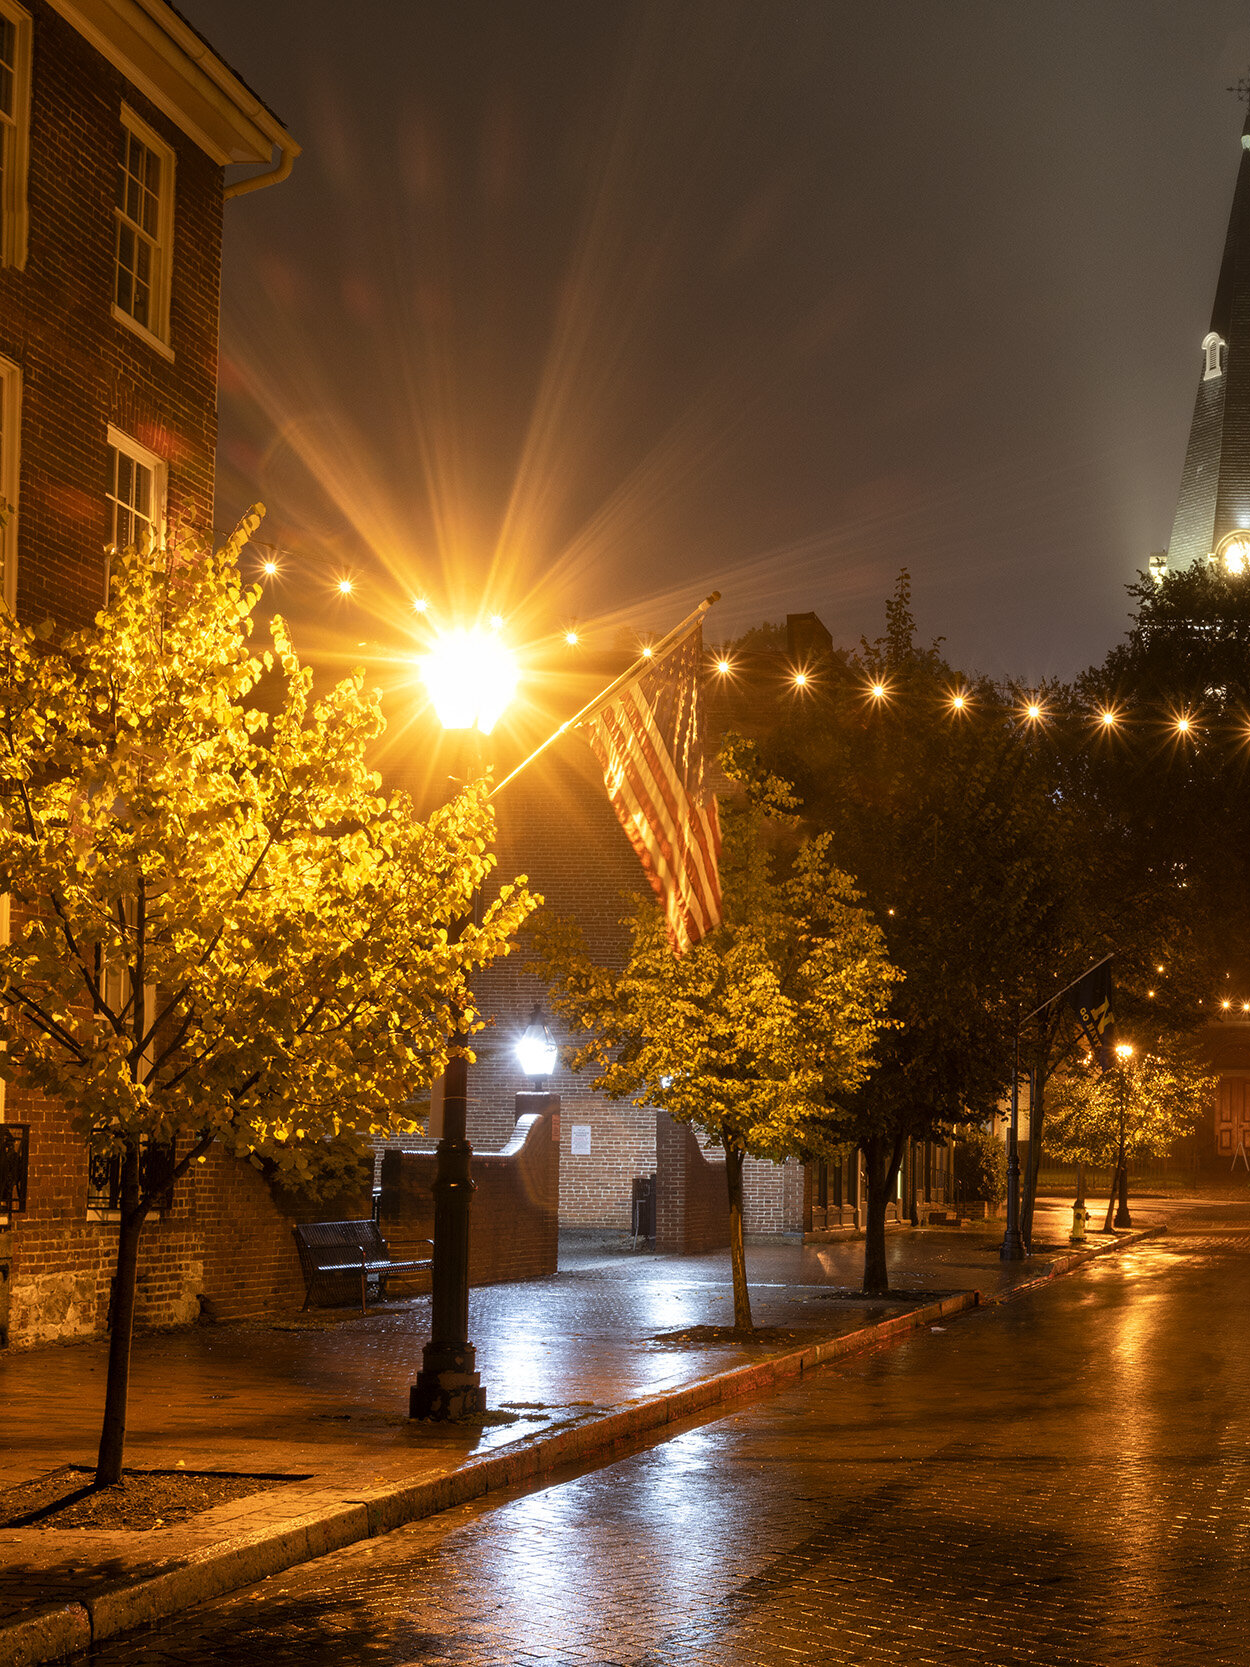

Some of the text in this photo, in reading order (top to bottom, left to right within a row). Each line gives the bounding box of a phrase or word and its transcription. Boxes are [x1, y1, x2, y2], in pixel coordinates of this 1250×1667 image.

[1079, 1007, 1103, 1048] GO NAVY
[1091, 995, 1115, 1034] N
